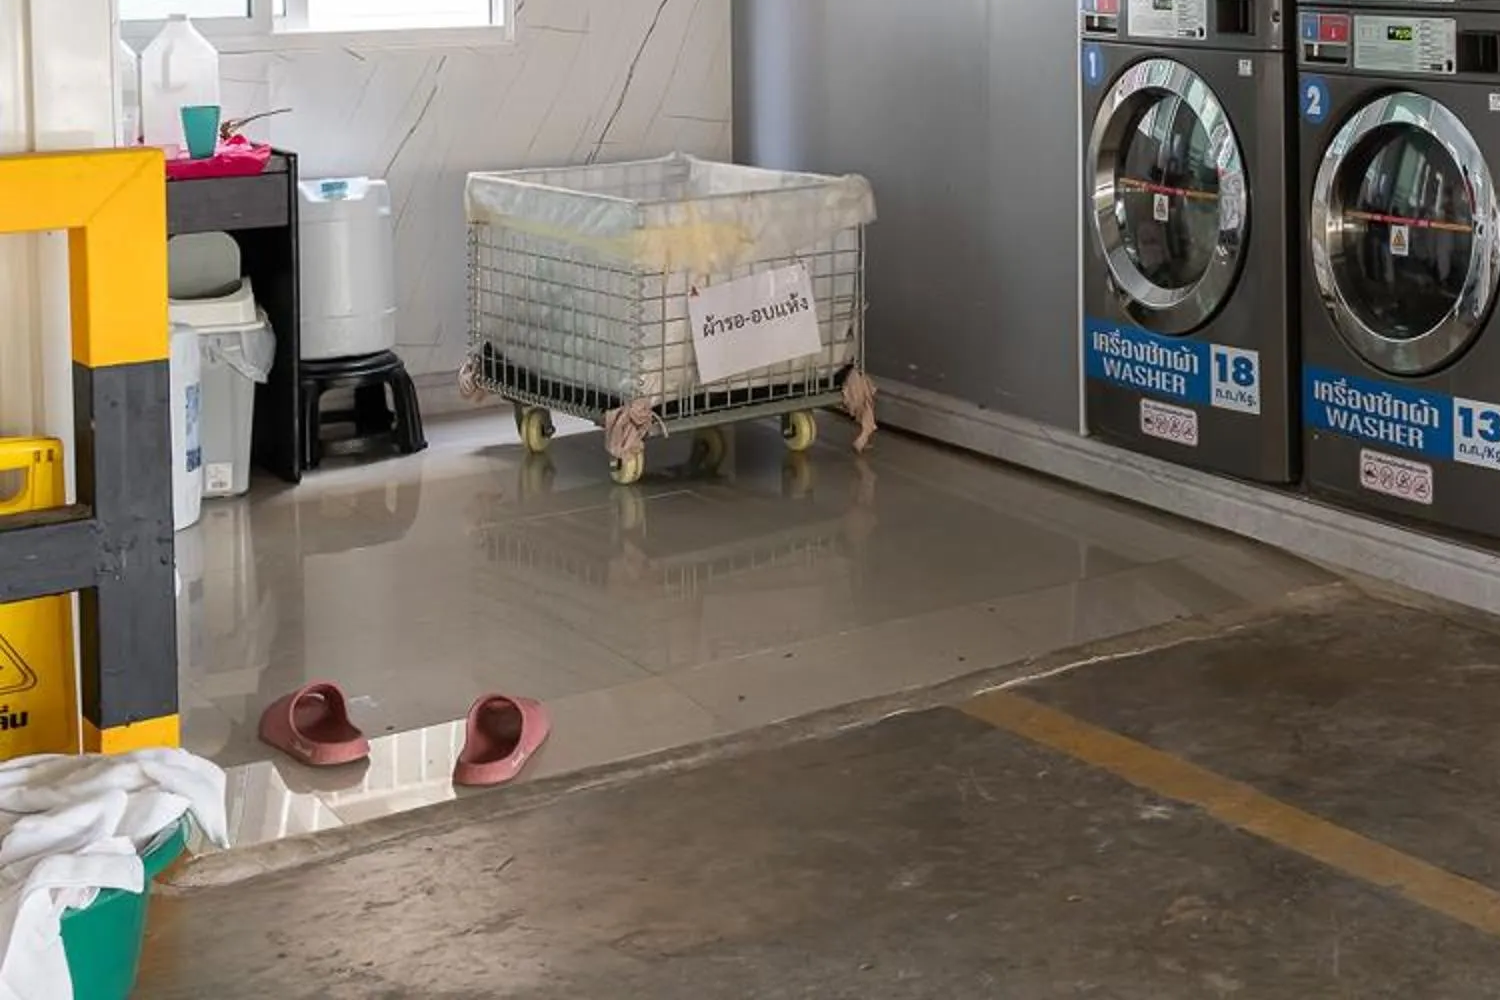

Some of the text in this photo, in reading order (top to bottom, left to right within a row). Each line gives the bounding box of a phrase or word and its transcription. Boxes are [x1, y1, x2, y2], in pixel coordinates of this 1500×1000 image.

[1088, 51, 1097, 78] 1
[1306, 85, 1321, 115] 2
[1102, 358, 1185, 395] WASHER
[1214, 352, 1255, 386] 18
[1313, 377, 1440, 428] เครื่องซักผ้า
[1325, 406, 1424, 449] WASHER
